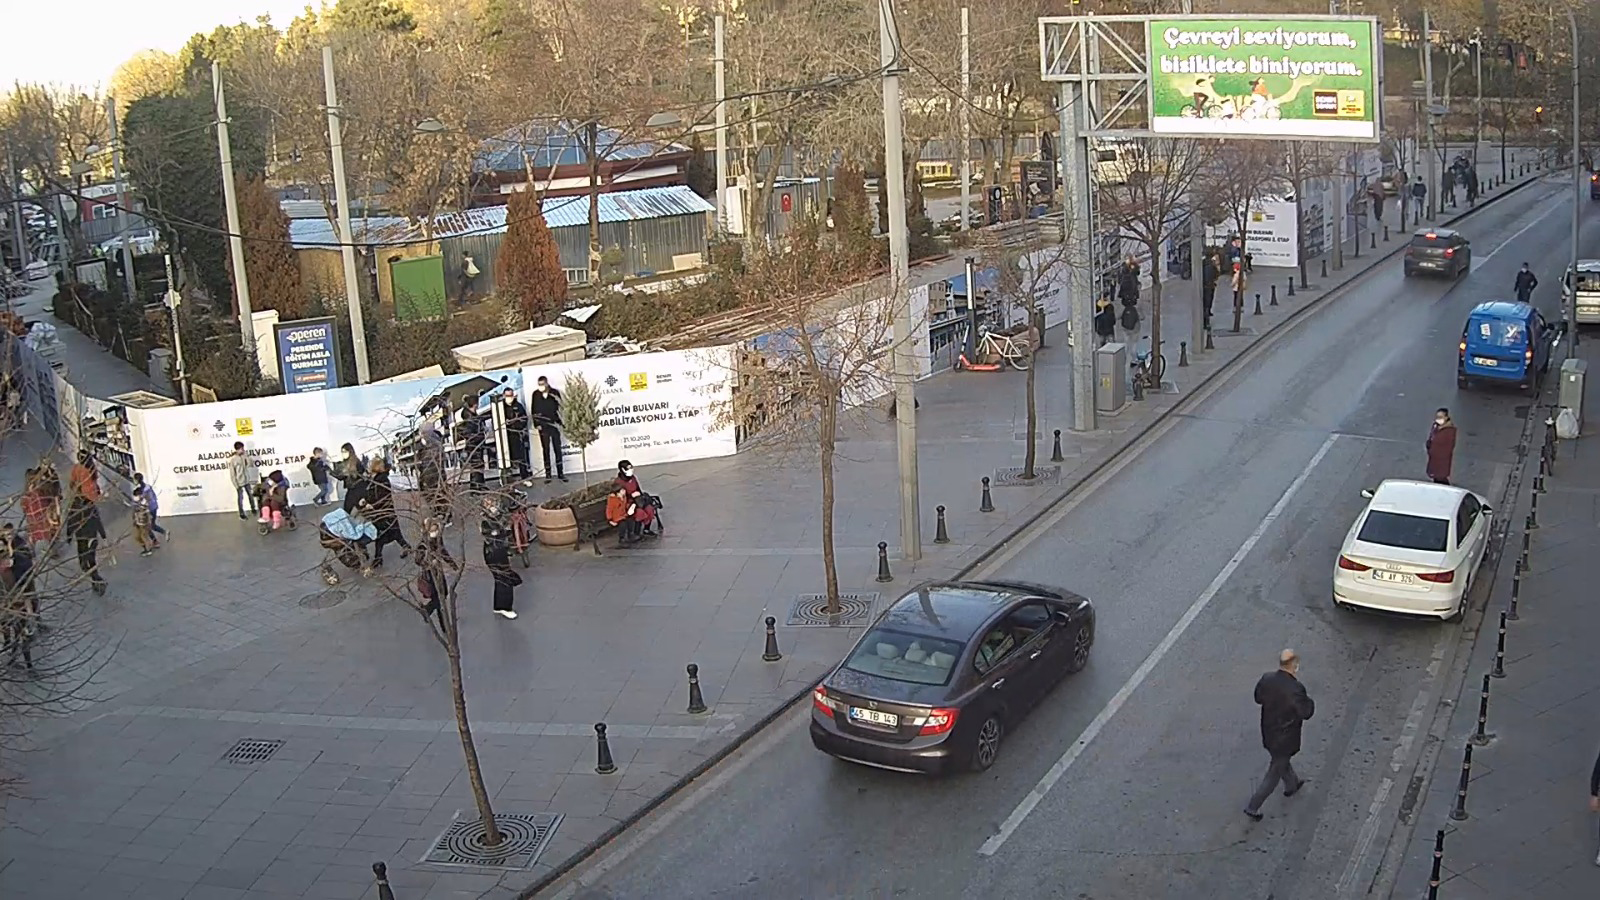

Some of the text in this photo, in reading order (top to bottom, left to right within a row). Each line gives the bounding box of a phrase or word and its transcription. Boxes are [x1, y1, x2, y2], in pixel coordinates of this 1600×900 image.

[1164, 26, 1357, 49] Çevreyi seviyorum,
[1160, 55, 1363, 79] bisiklete biniyorum.
[291, 343, 324, 353] PERENDE
[312, 351, 330, 359] ASLA
[292, 360, 322, 369] DURMAZ
[633, 402, 669, 412] BULVARI
[668, 412, 676, 420] 2.
[678, 409, 700, 419] ETAP
[173, 465, 198, 474] CEPHE
[285, 455, 305, 463] ETAP
[854, 709, 897, 724] 45 TB 143
